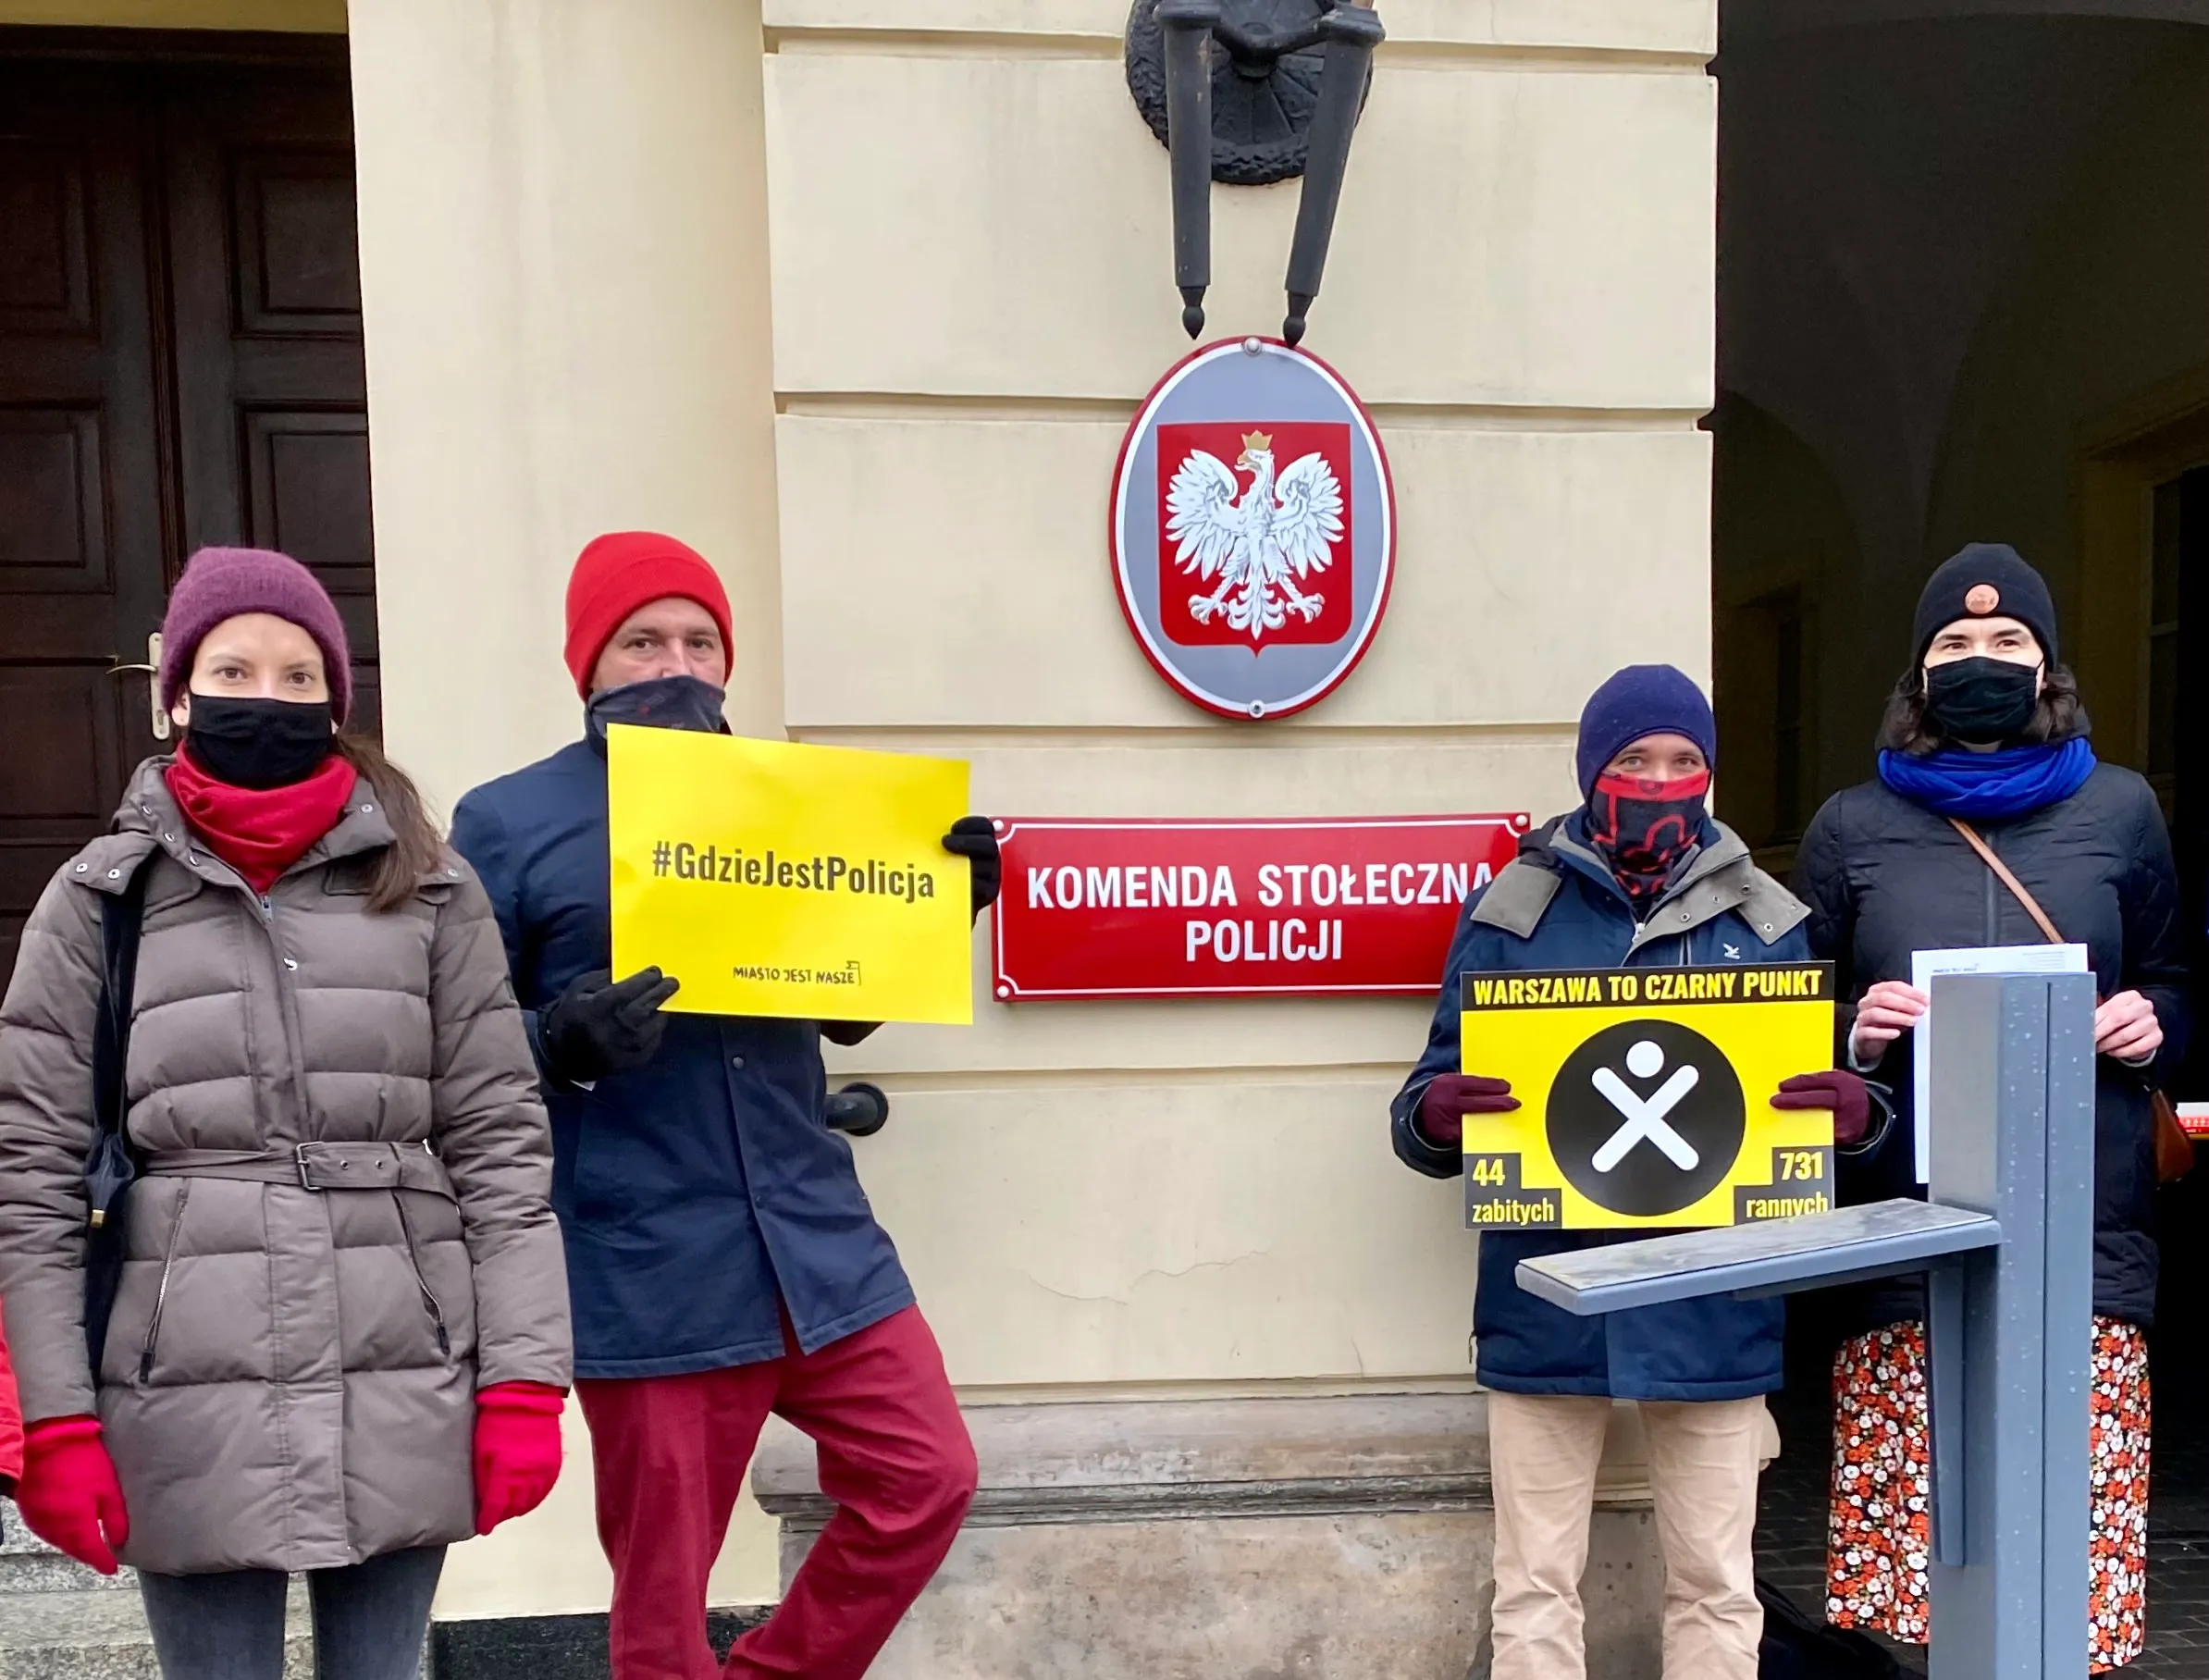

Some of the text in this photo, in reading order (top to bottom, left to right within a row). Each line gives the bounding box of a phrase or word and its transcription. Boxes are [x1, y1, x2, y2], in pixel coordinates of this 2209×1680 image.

[652, 840, 934, 904] #GdzieJestPolicja
[1027, 862, 1492, 909] KOMENDA STOŁECZNA
[1186, 919, 1342, 962] POLICJI
[733, 966, 856, 984] MIASTO JEST NASZE
[1474, 970, 1823, 1006] WARSZAWA TO CZARNY PUNKT
[1472, 1158, 1506, 1187] 44
[1779, 1152, 1823, 1180] 731
[1473, 1198, 1555, 1227] zabitych
[1746, 1191, 1828, 1218] rannych
